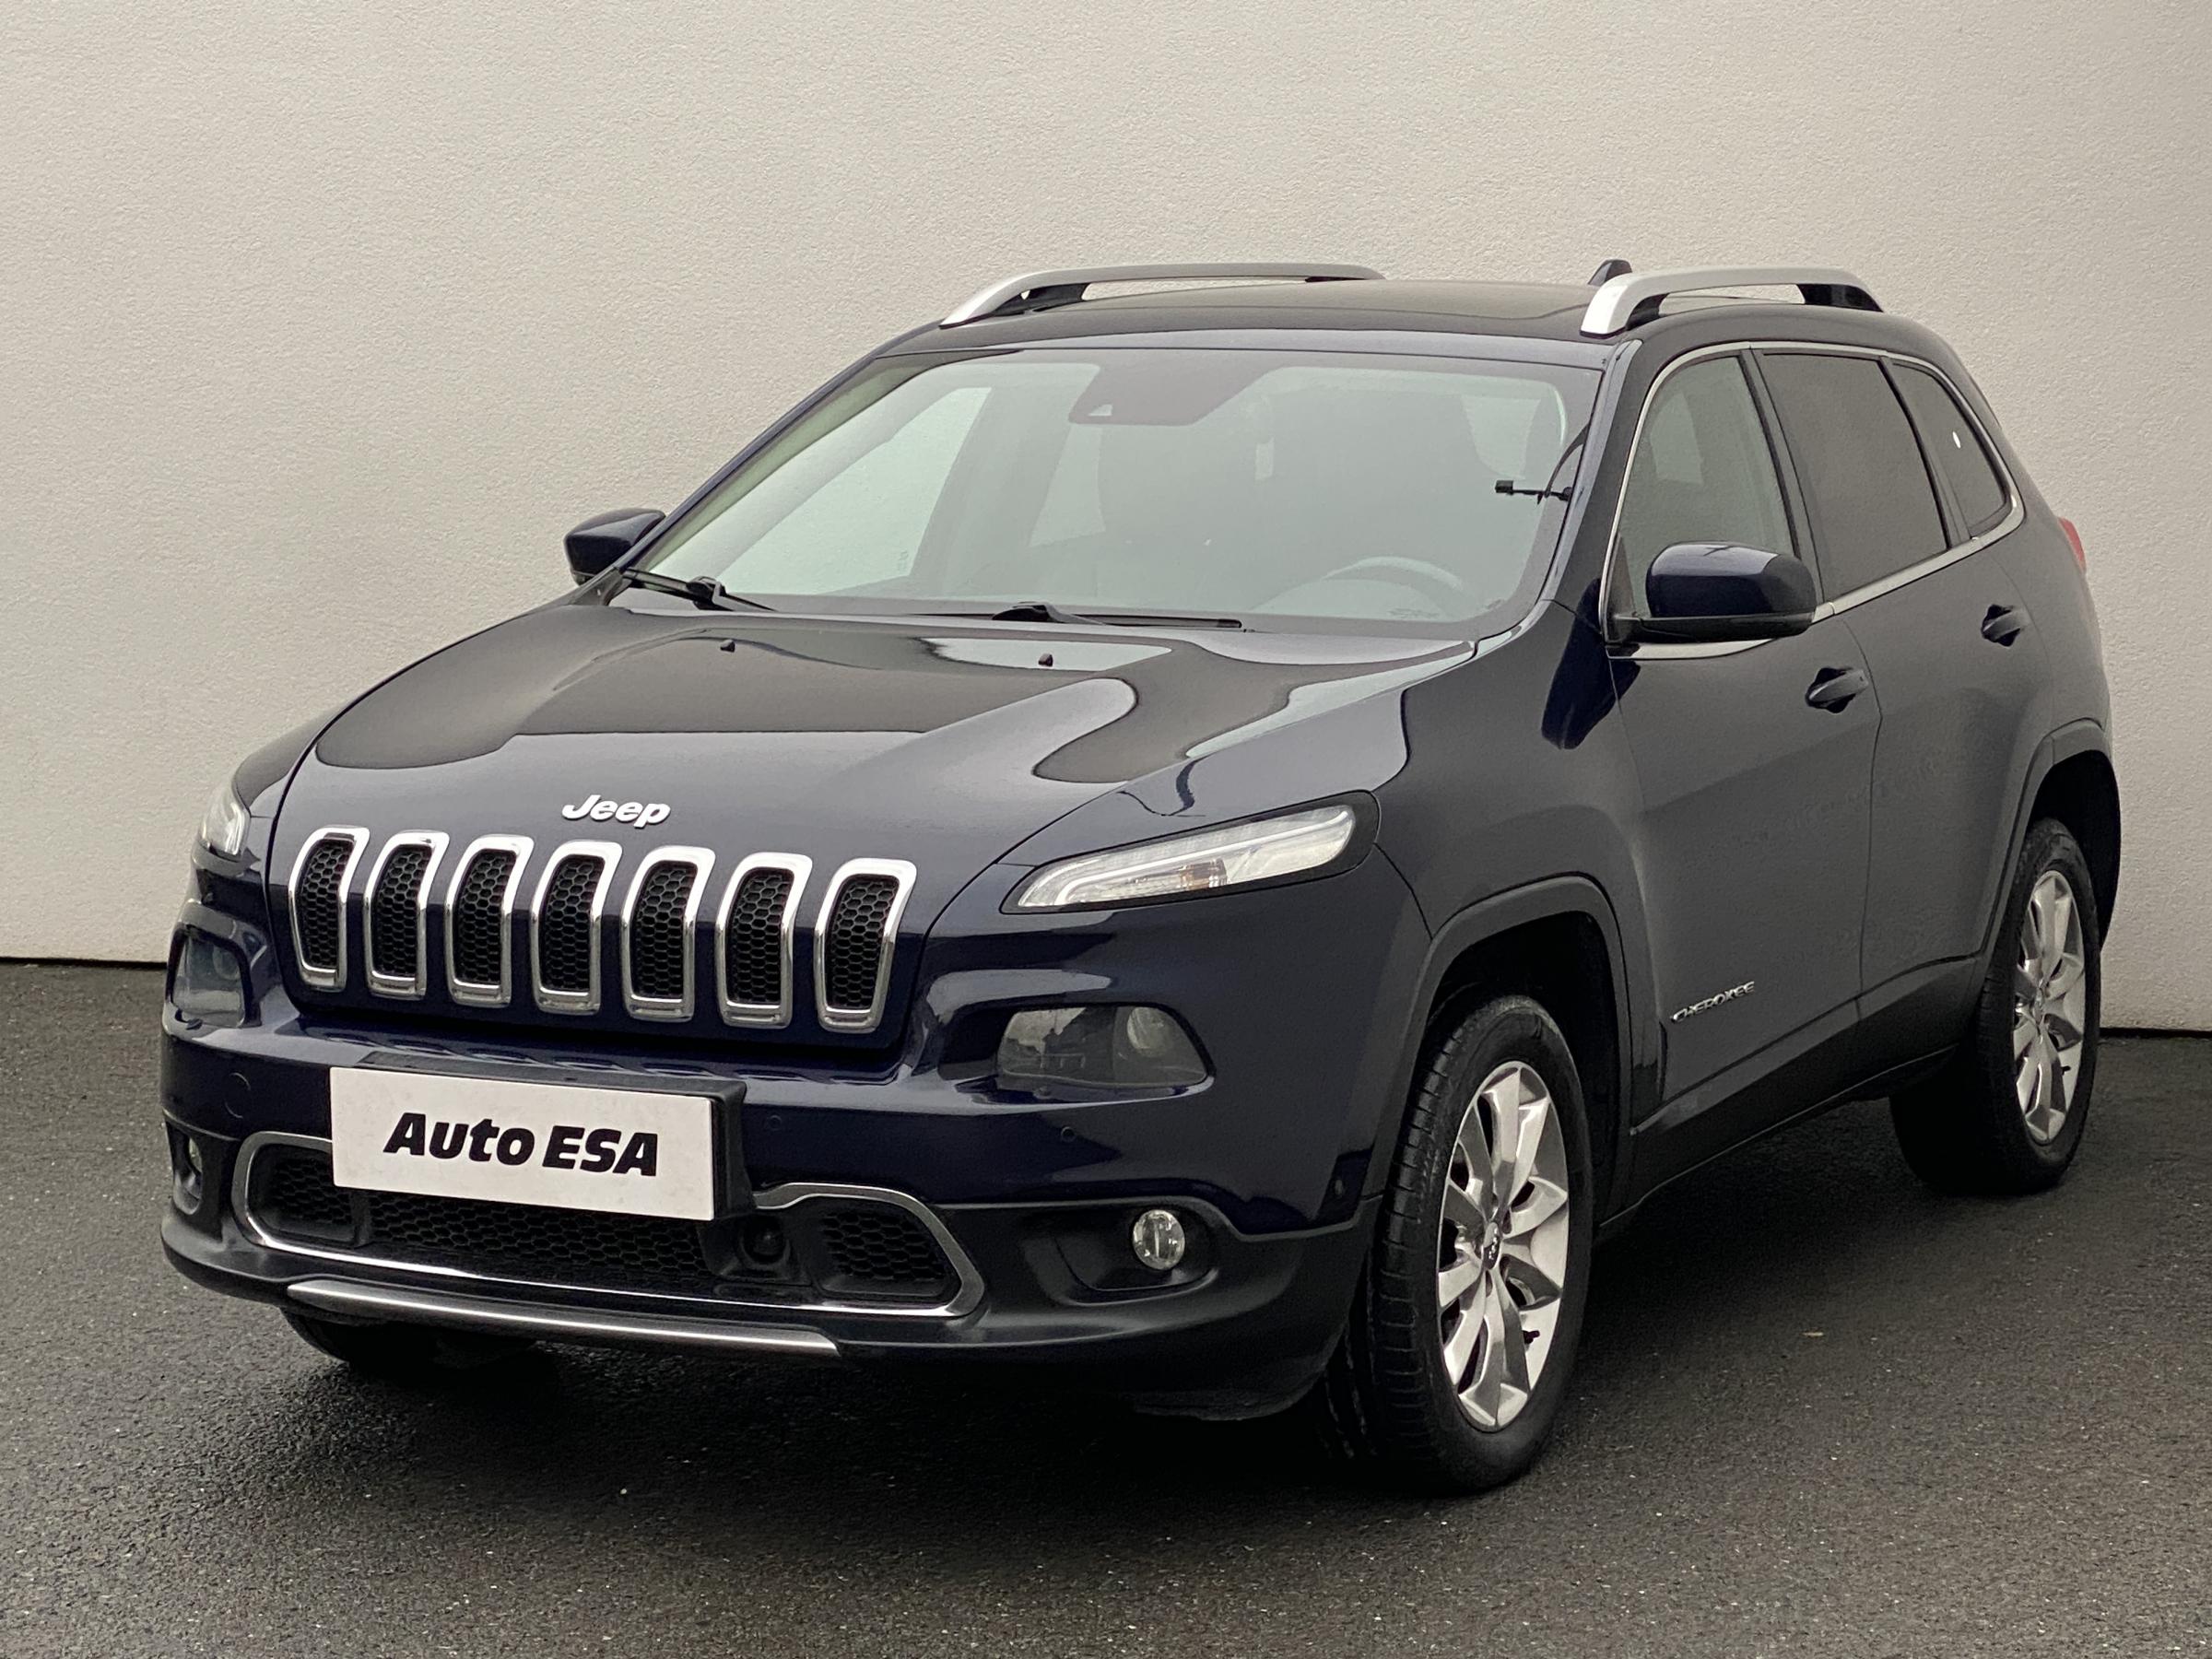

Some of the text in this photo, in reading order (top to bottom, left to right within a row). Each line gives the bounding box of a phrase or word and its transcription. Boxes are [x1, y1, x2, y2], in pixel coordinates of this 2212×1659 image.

[561, 794, 671, 829] Jeep
[1670, 981, 1756, 1022] CHEROKEE
[382, 1112, 658, 1177] Auto ESA
